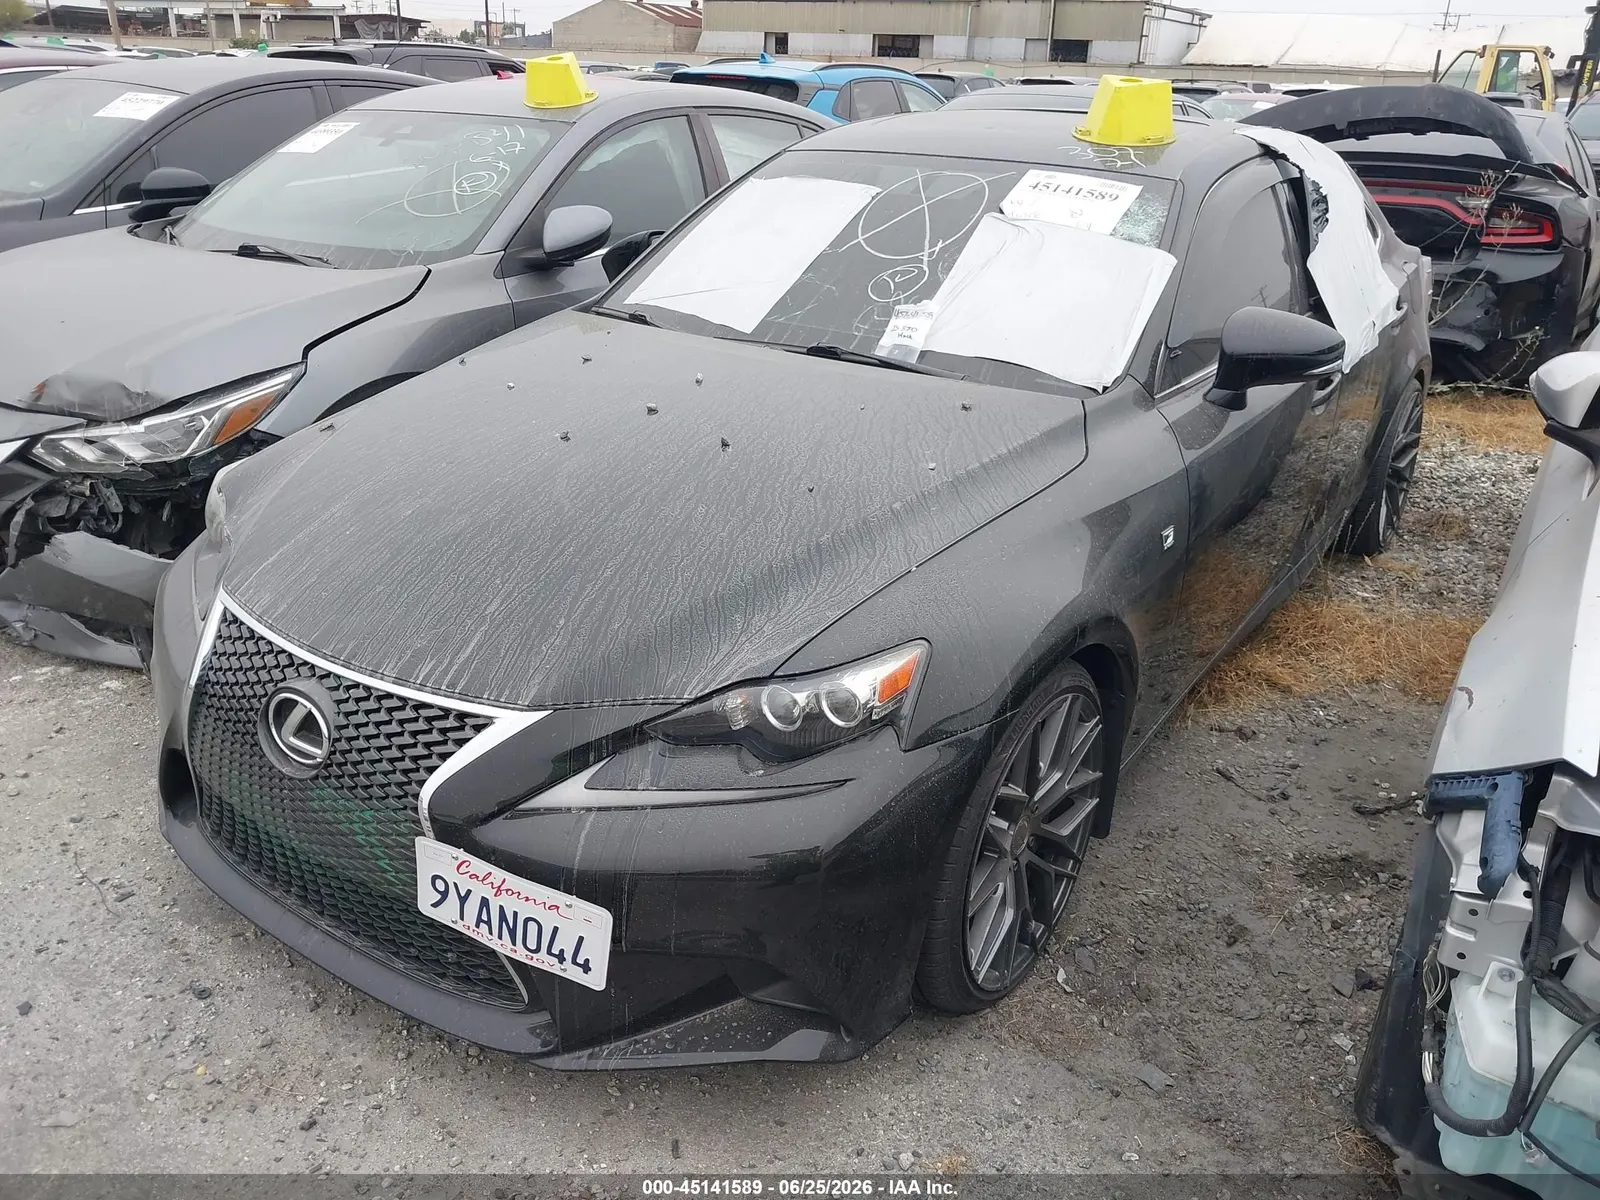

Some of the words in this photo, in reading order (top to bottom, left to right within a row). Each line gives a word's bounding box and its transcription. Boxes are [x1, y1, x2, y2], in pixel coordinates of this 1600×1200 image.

[1028, 181, 1120, 202] 45141589
[456, 859, 573, 920] California
[430, 874, 592, 975] 9YAN044
[461, 922, 557, 968] dmv.ca.gov
